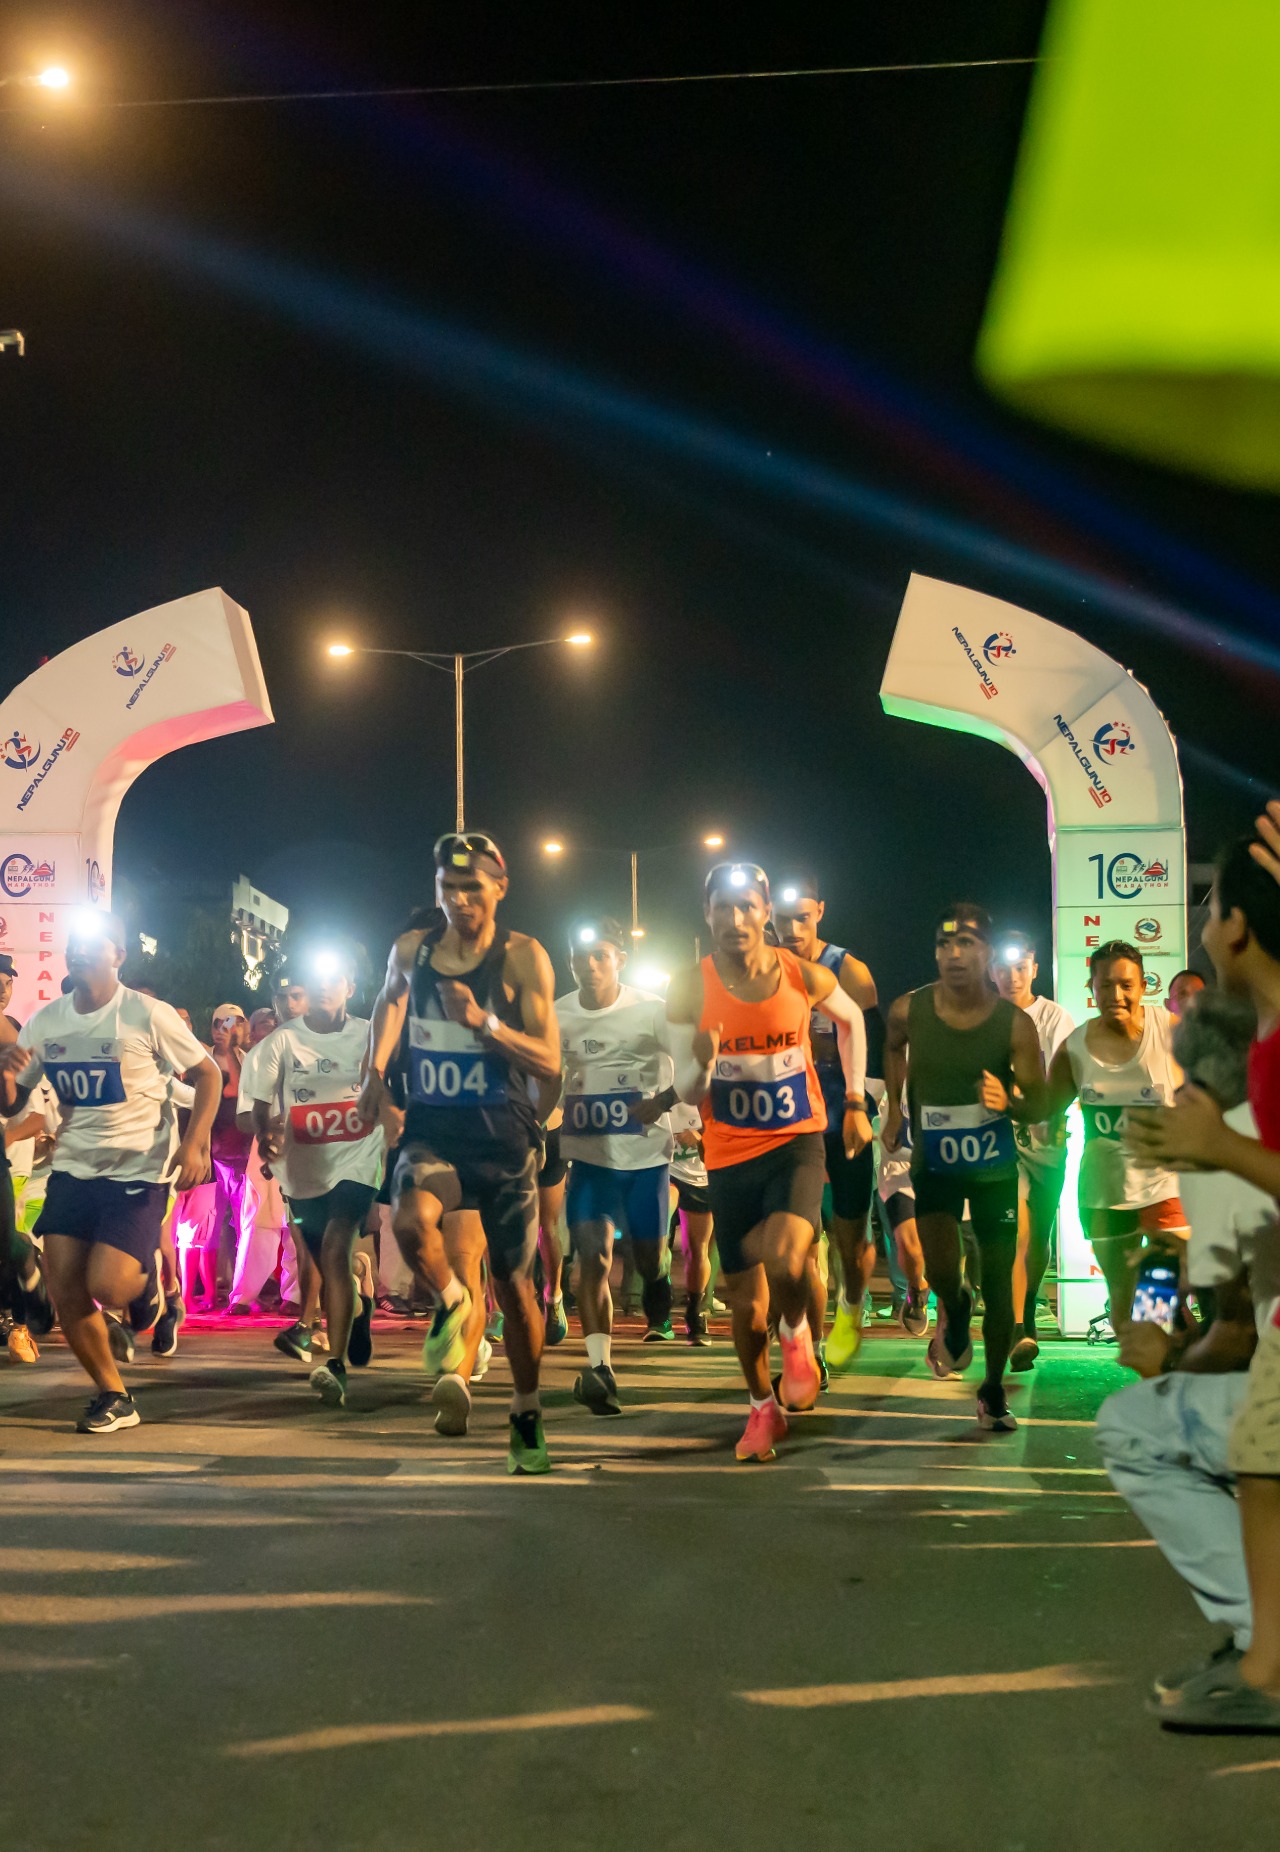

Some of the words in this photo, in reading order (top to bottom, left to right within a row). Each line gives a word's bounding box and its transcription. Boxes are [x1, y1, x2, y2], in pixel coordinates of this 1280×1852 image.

[7, 875, 56, 883] NEPALGUNJ
[1087, 852, 1144, 900] 10
[1115, 875, 1169, 883] NEPALGUNJ
[719, 1031, 797, 1052] KELME
[56, 1069, 107, 1100] 007
[420, 1058, 488, 1098] 004
[573, 1099, 629, 1129] 009
[729, 1085, 796, 1122] 003
[305, 1106, 363, 1138] 026
[940, 1130, 1000, 1165] 002
